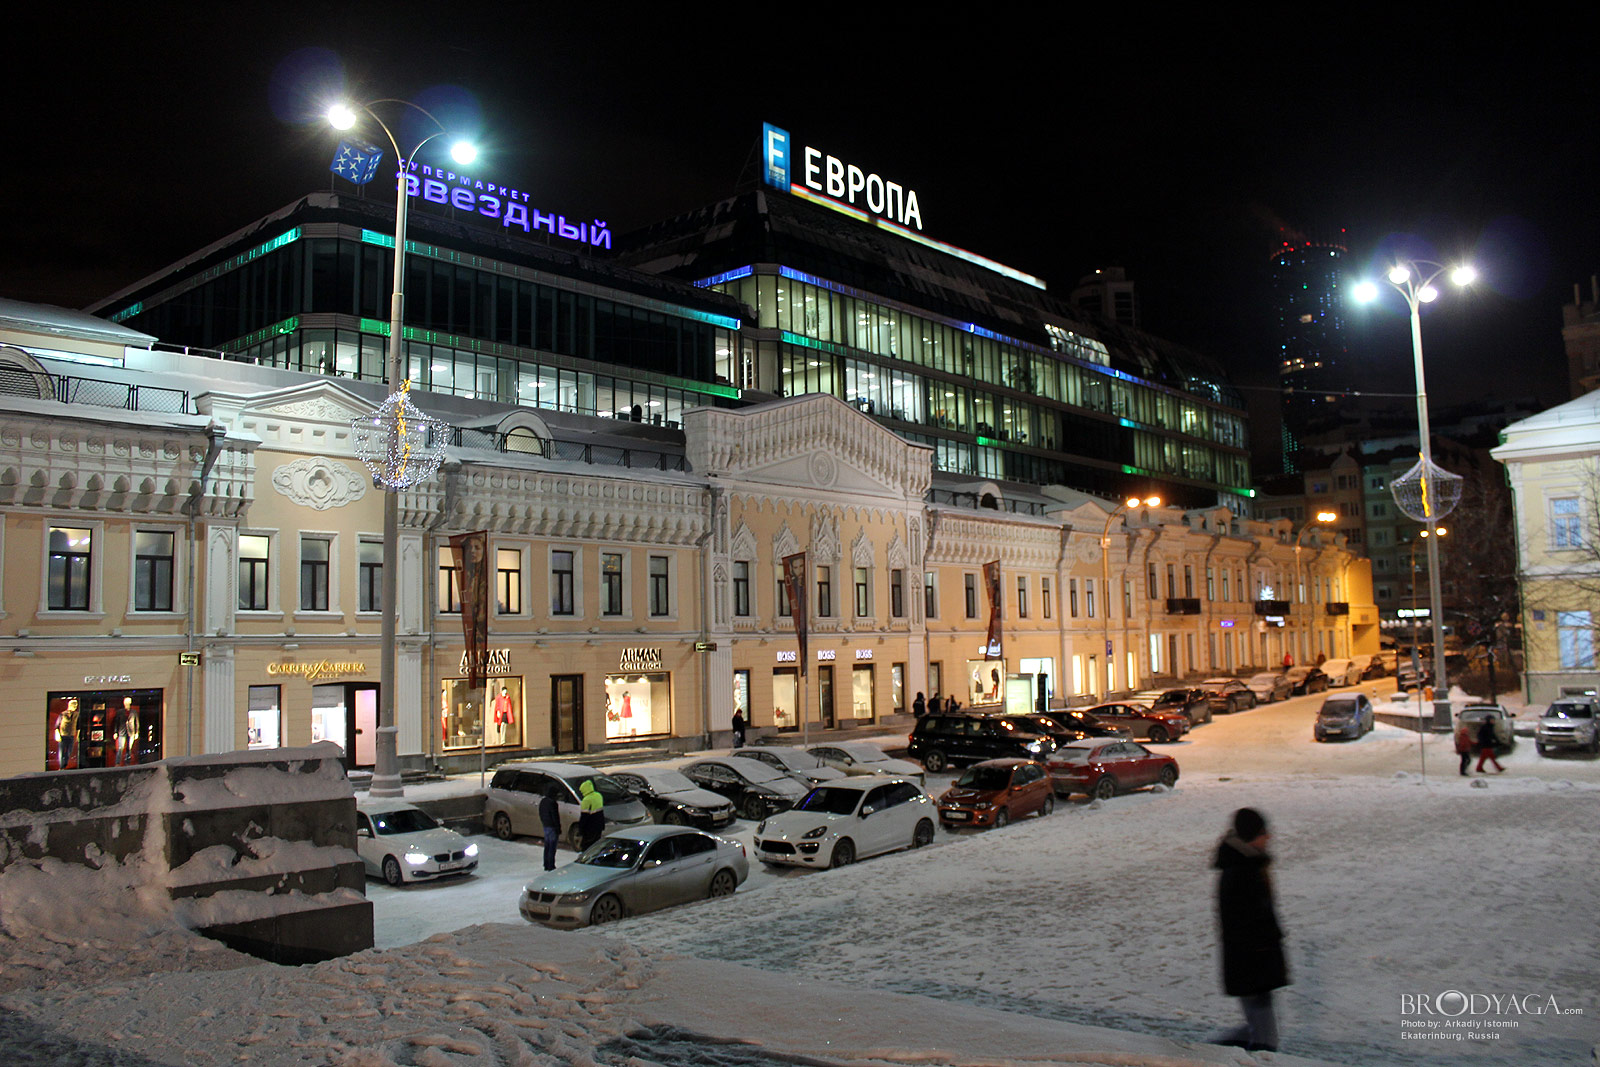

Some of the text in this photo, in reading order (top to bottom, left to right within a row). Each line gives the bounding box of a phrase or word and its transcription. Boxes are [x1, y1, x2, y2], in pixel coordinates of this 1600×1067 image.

[398, 158, 531, 203] СУПЕРМАРКЕТ
[804, 145, 923, 231] ЕВРОПА
[619, 647, 662, 662] ARMANI
